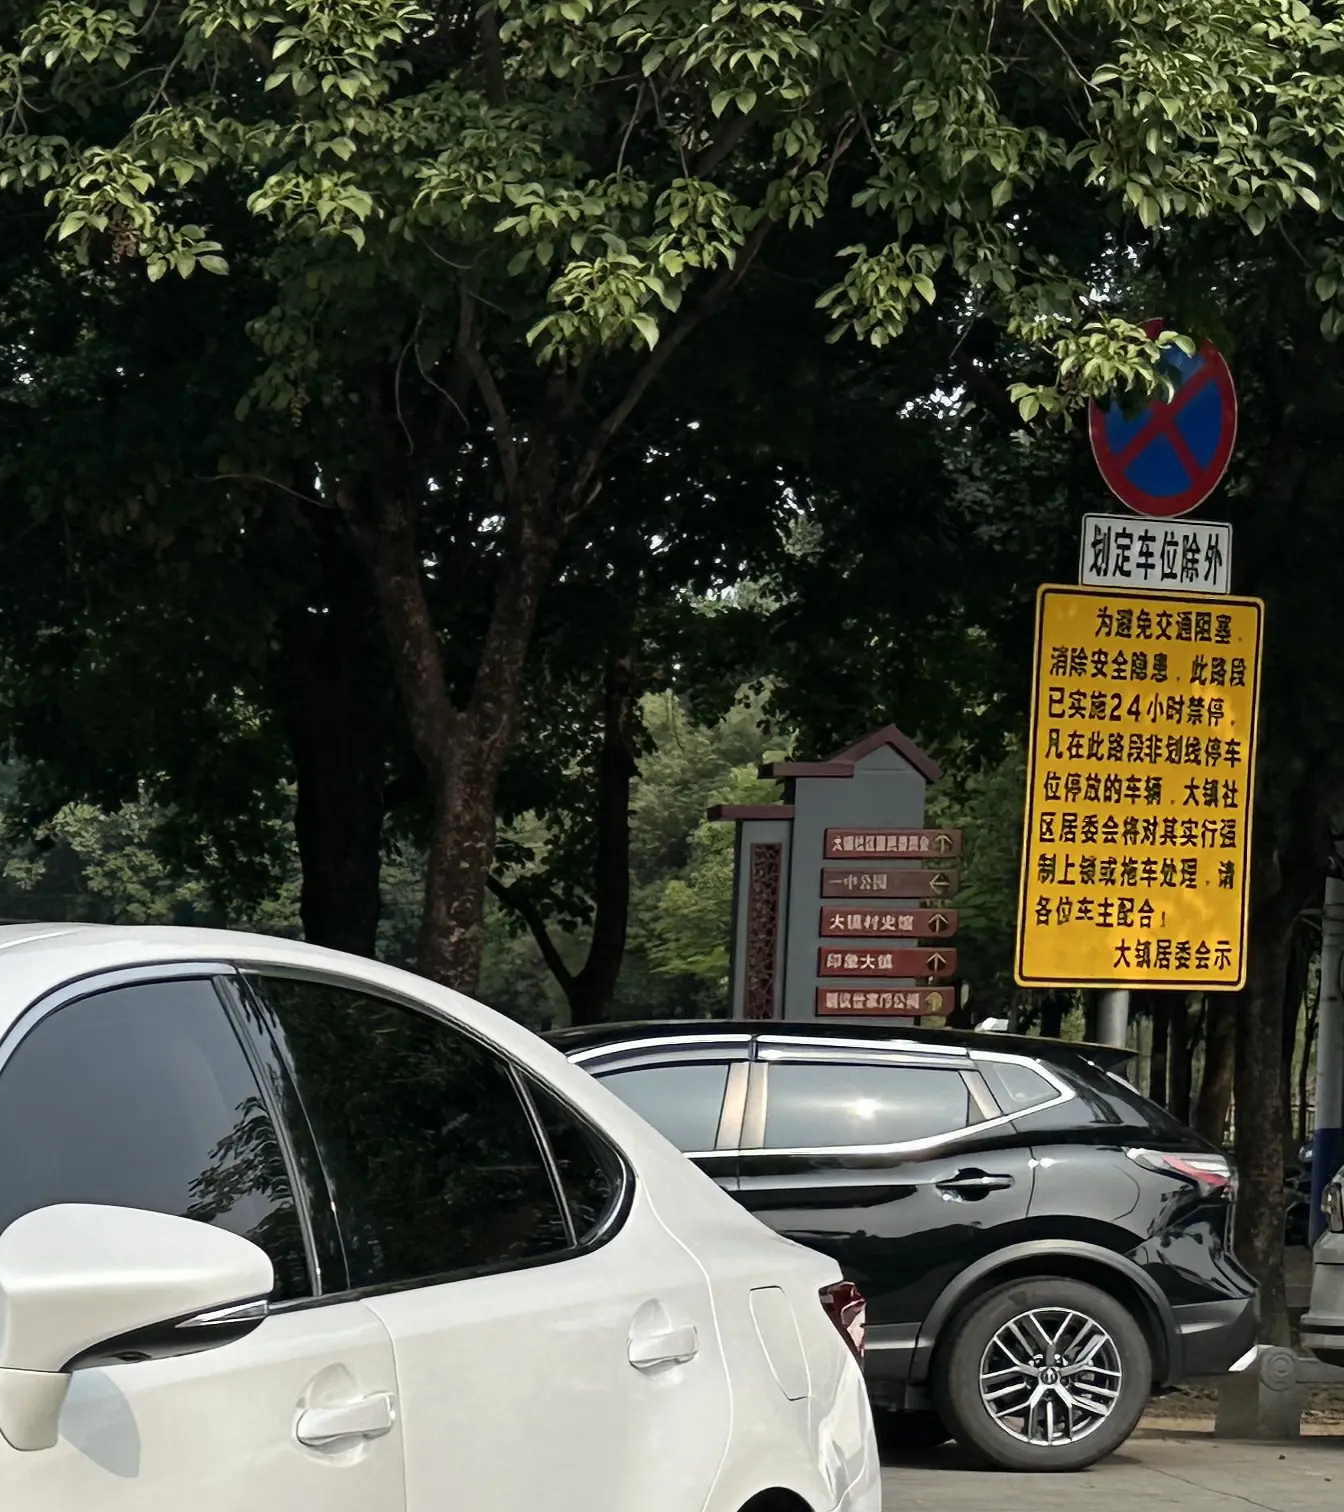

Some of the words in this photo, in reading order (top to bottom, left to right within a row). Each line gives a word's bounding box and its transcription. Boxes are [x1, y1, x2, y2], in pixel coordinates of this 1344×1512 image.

[1089, 526, 1223, 584] 划定车位除外
[1044, 727, 1242, 769] 凡在此路段非划线停车
[1038, 811, 1237, 849] 区居委会将对其实行强
[1113, 937, 1233, 971] 大镇居委会示
